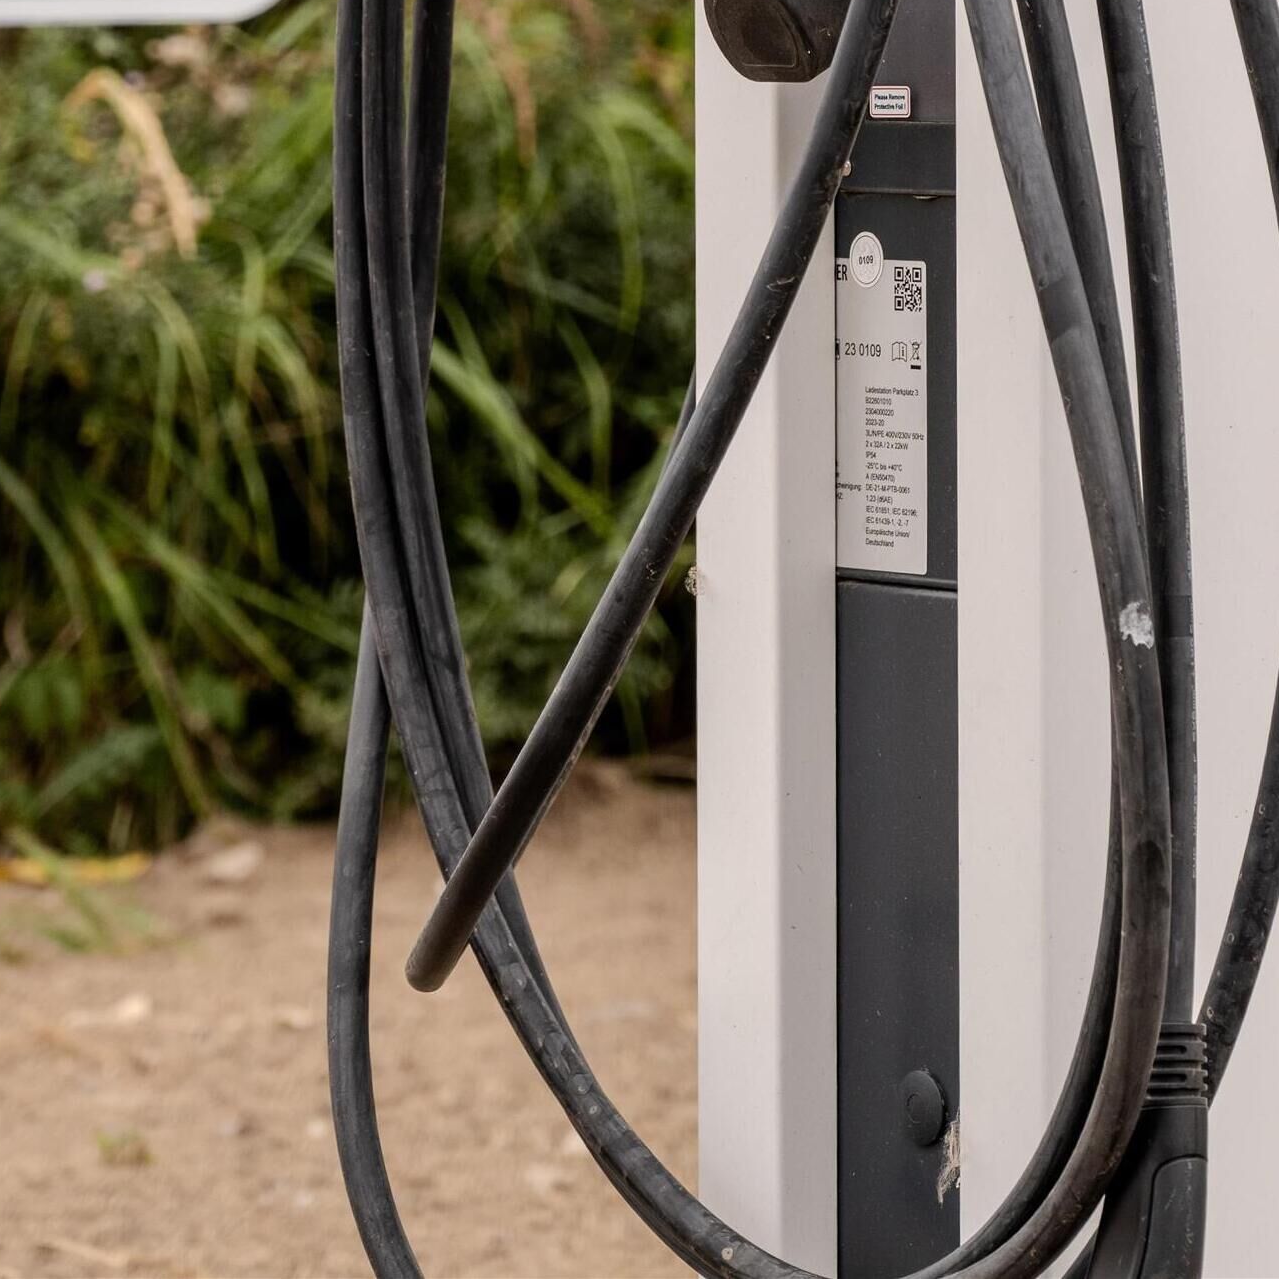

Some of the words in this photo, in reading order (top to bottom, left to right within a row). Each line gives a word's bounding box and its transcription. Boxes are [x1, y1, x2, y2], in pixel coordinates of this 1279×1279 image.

[858, 255, 874, 265] 0109
[844, 342, 856, 356] 23
[859, 343, 882, 357] 0109
[865, 386, 892, 395] Ladestation
[893, 387, 914, 396] Parkplatz
